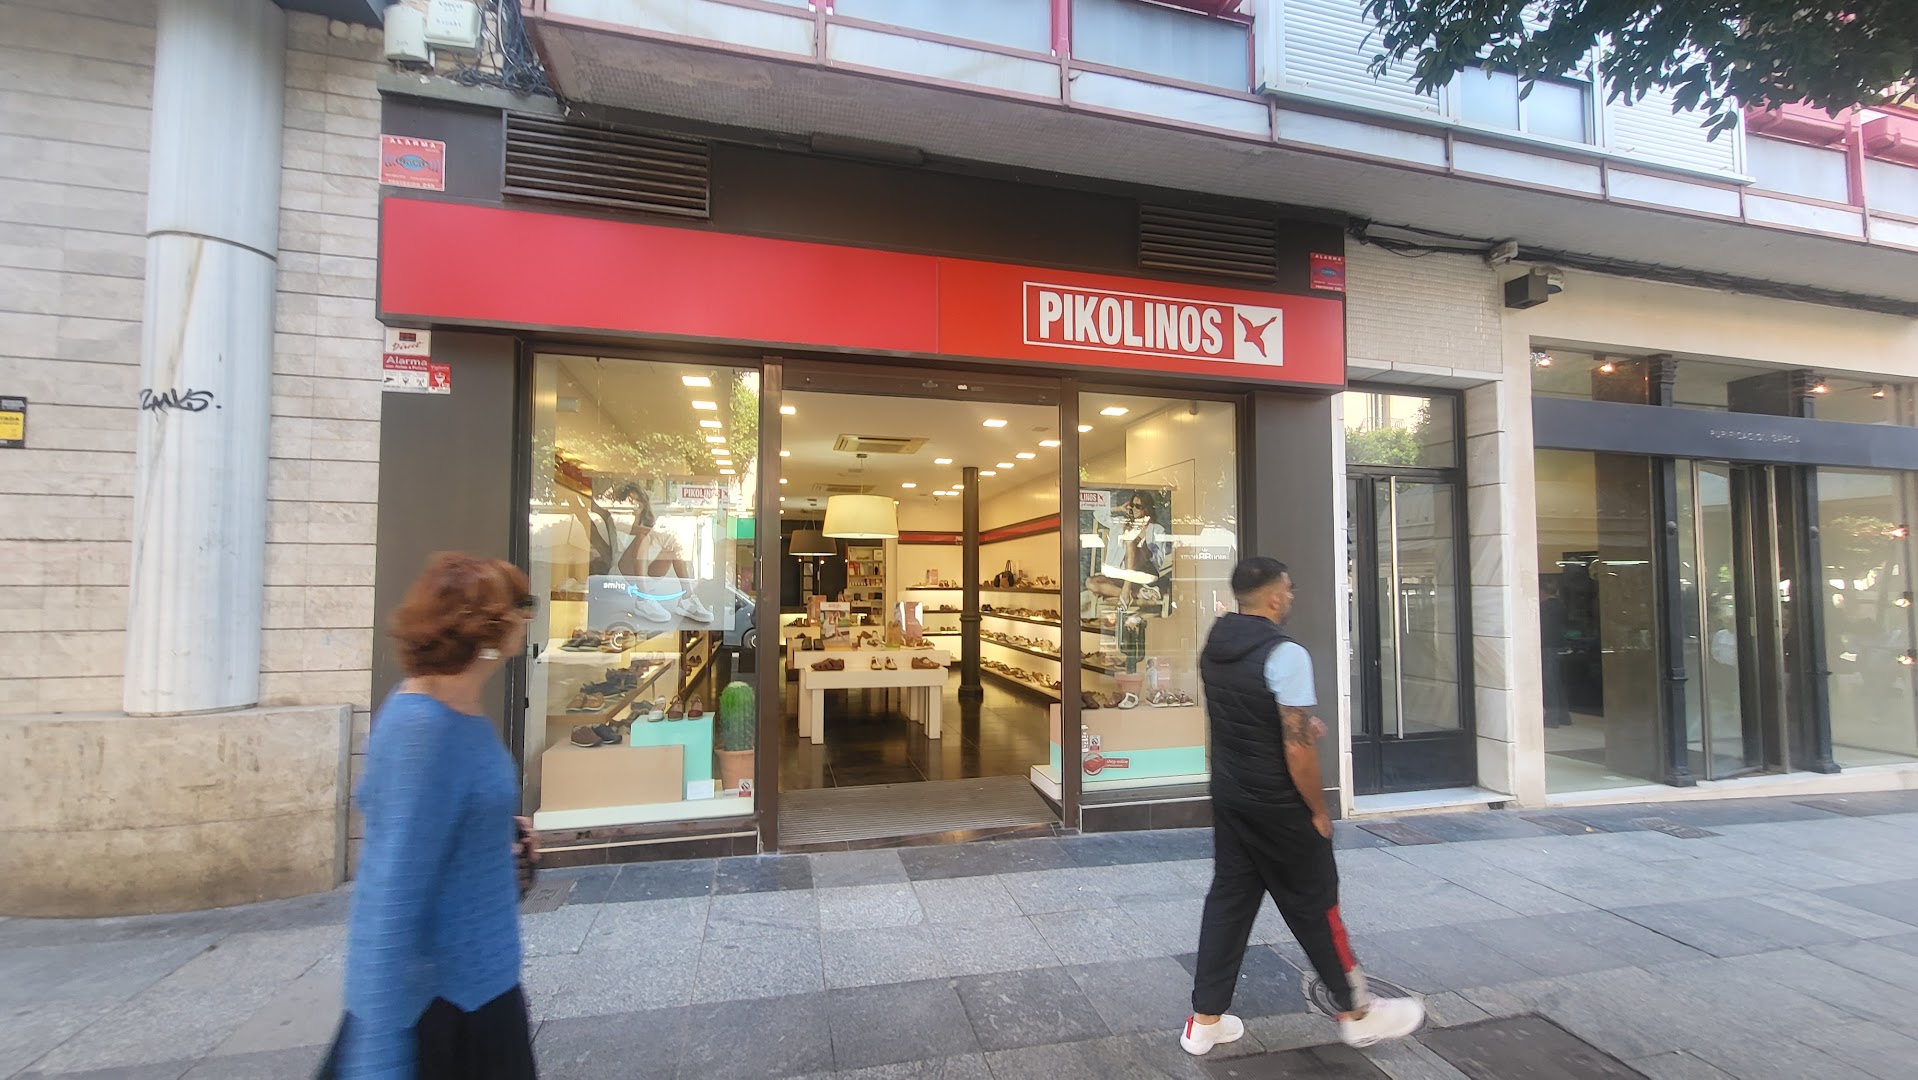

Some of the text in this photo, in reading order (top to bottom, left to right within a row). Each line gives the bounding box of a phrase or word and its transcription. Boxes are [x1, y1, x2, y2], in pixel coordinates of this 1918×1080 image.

[389, 137, 436, 149] ALARMA
[1039, 290, 1223, 355] PIKOLINOS
[386, 355, 428, 366] Alarma
